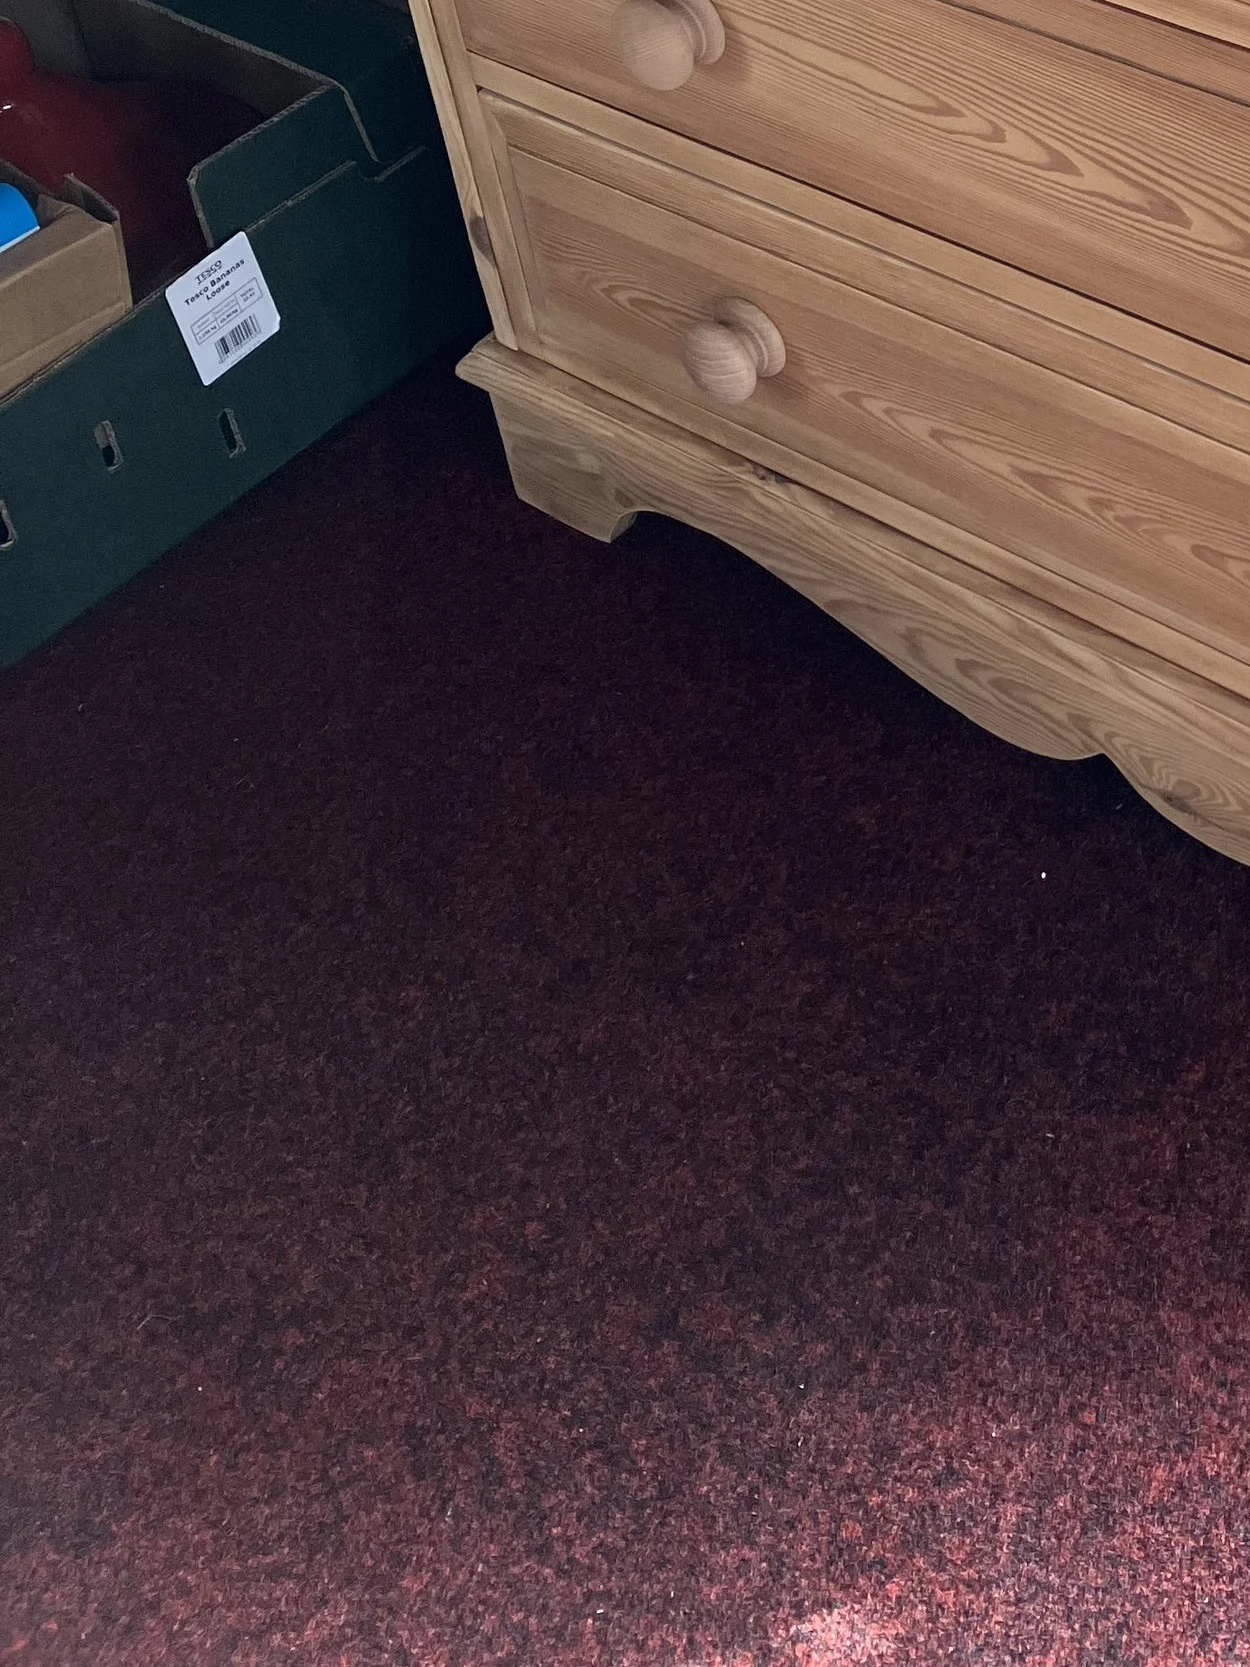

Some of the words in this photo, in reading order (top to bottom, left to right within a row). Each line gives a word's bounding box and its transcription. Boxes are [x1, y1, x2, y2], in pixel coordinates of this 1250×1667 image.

[184, 286, 209, 306] Tesco
[209, 258, 245, 287] Bananas
[194, 260, 223, 283] TESCO
[206, 280, 231, 301] Loose
